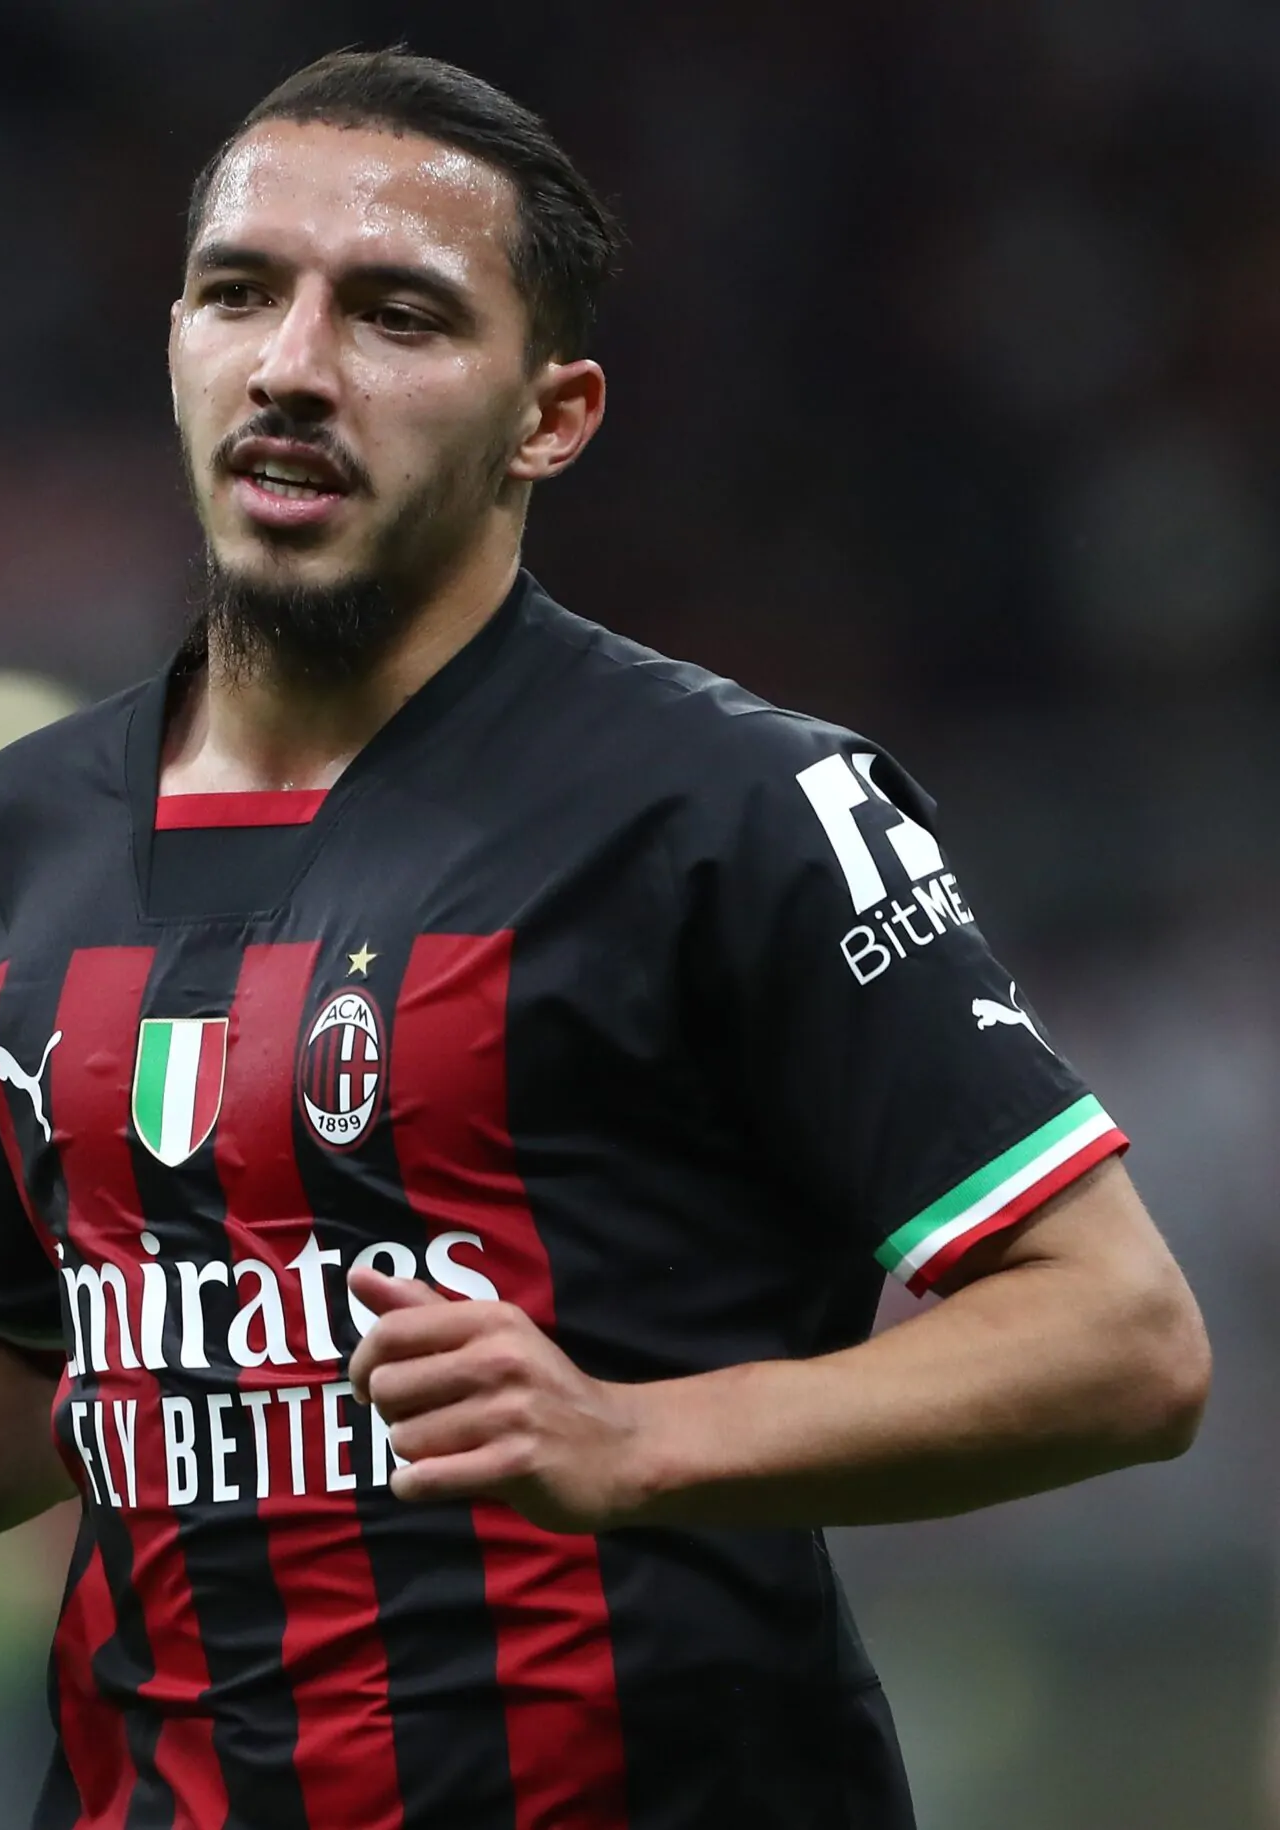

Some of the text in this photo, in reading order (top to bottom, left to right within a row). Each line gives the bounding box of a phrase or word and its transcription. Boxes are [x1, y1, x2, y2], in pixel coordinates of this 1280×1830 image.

[321, 1000, 369, 1027] ACM
[318, 1115, 361, 1132] 1899
[55, 1230, 500, 1378] mirates
[71, 1400, 137, 1509] FLY
